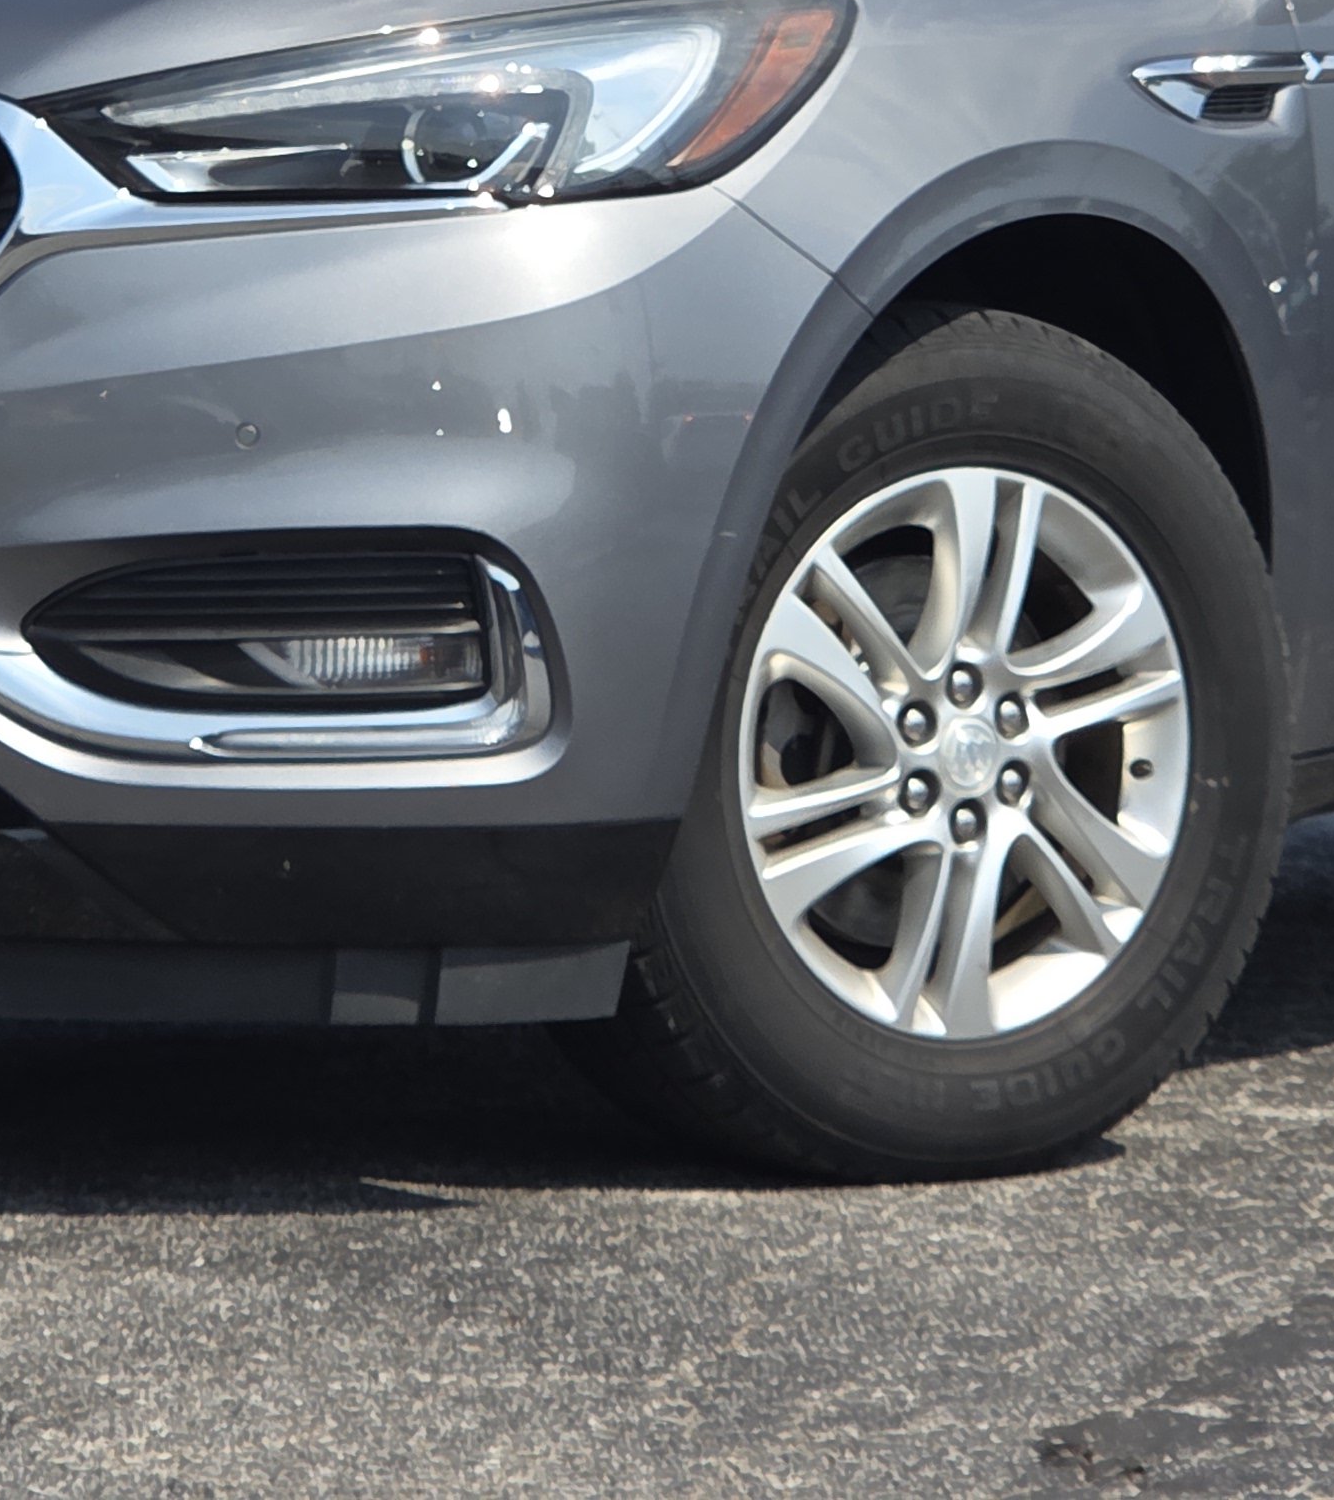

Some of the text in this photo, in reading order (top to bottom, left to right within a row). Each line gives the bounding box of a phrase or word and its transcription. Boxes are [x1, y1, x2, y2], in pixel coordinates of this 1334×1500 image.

[836, 388, 999, 473] GUIDE
[970, 833, 1251, 1112] TRAIL GUIDE
